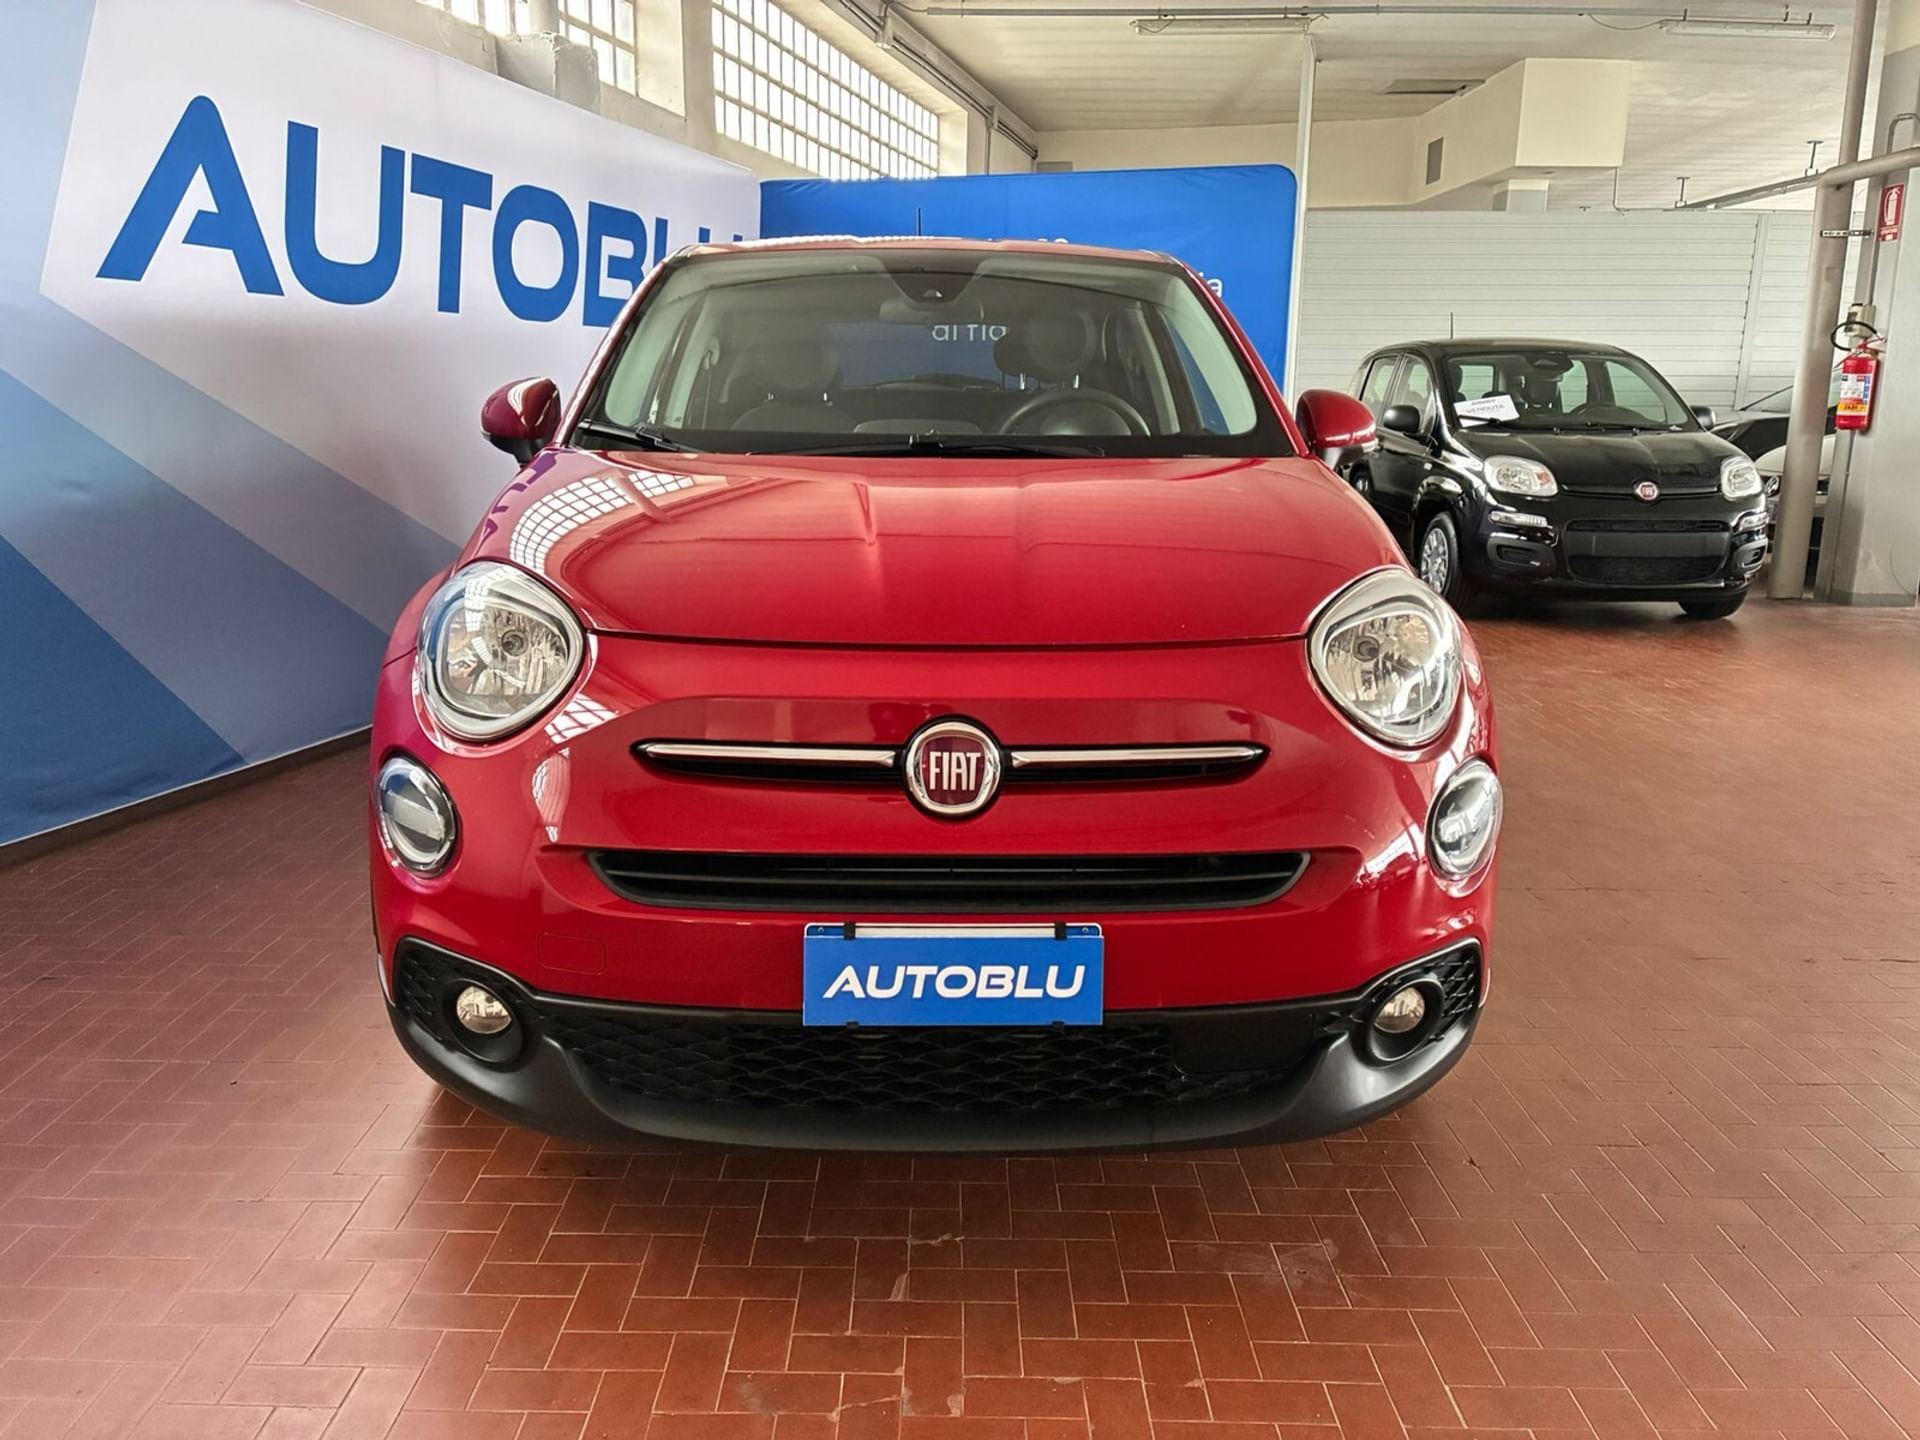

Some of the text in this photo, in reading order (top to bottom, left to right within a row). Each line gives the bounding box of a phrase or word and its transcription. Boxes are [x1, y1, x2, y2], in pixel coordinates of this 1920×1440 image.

[96, 95, 743, 327] AUTOB
[929, 751, 981, 791] FIAT
[822, 965, 1085, 999] AUTOBLU
